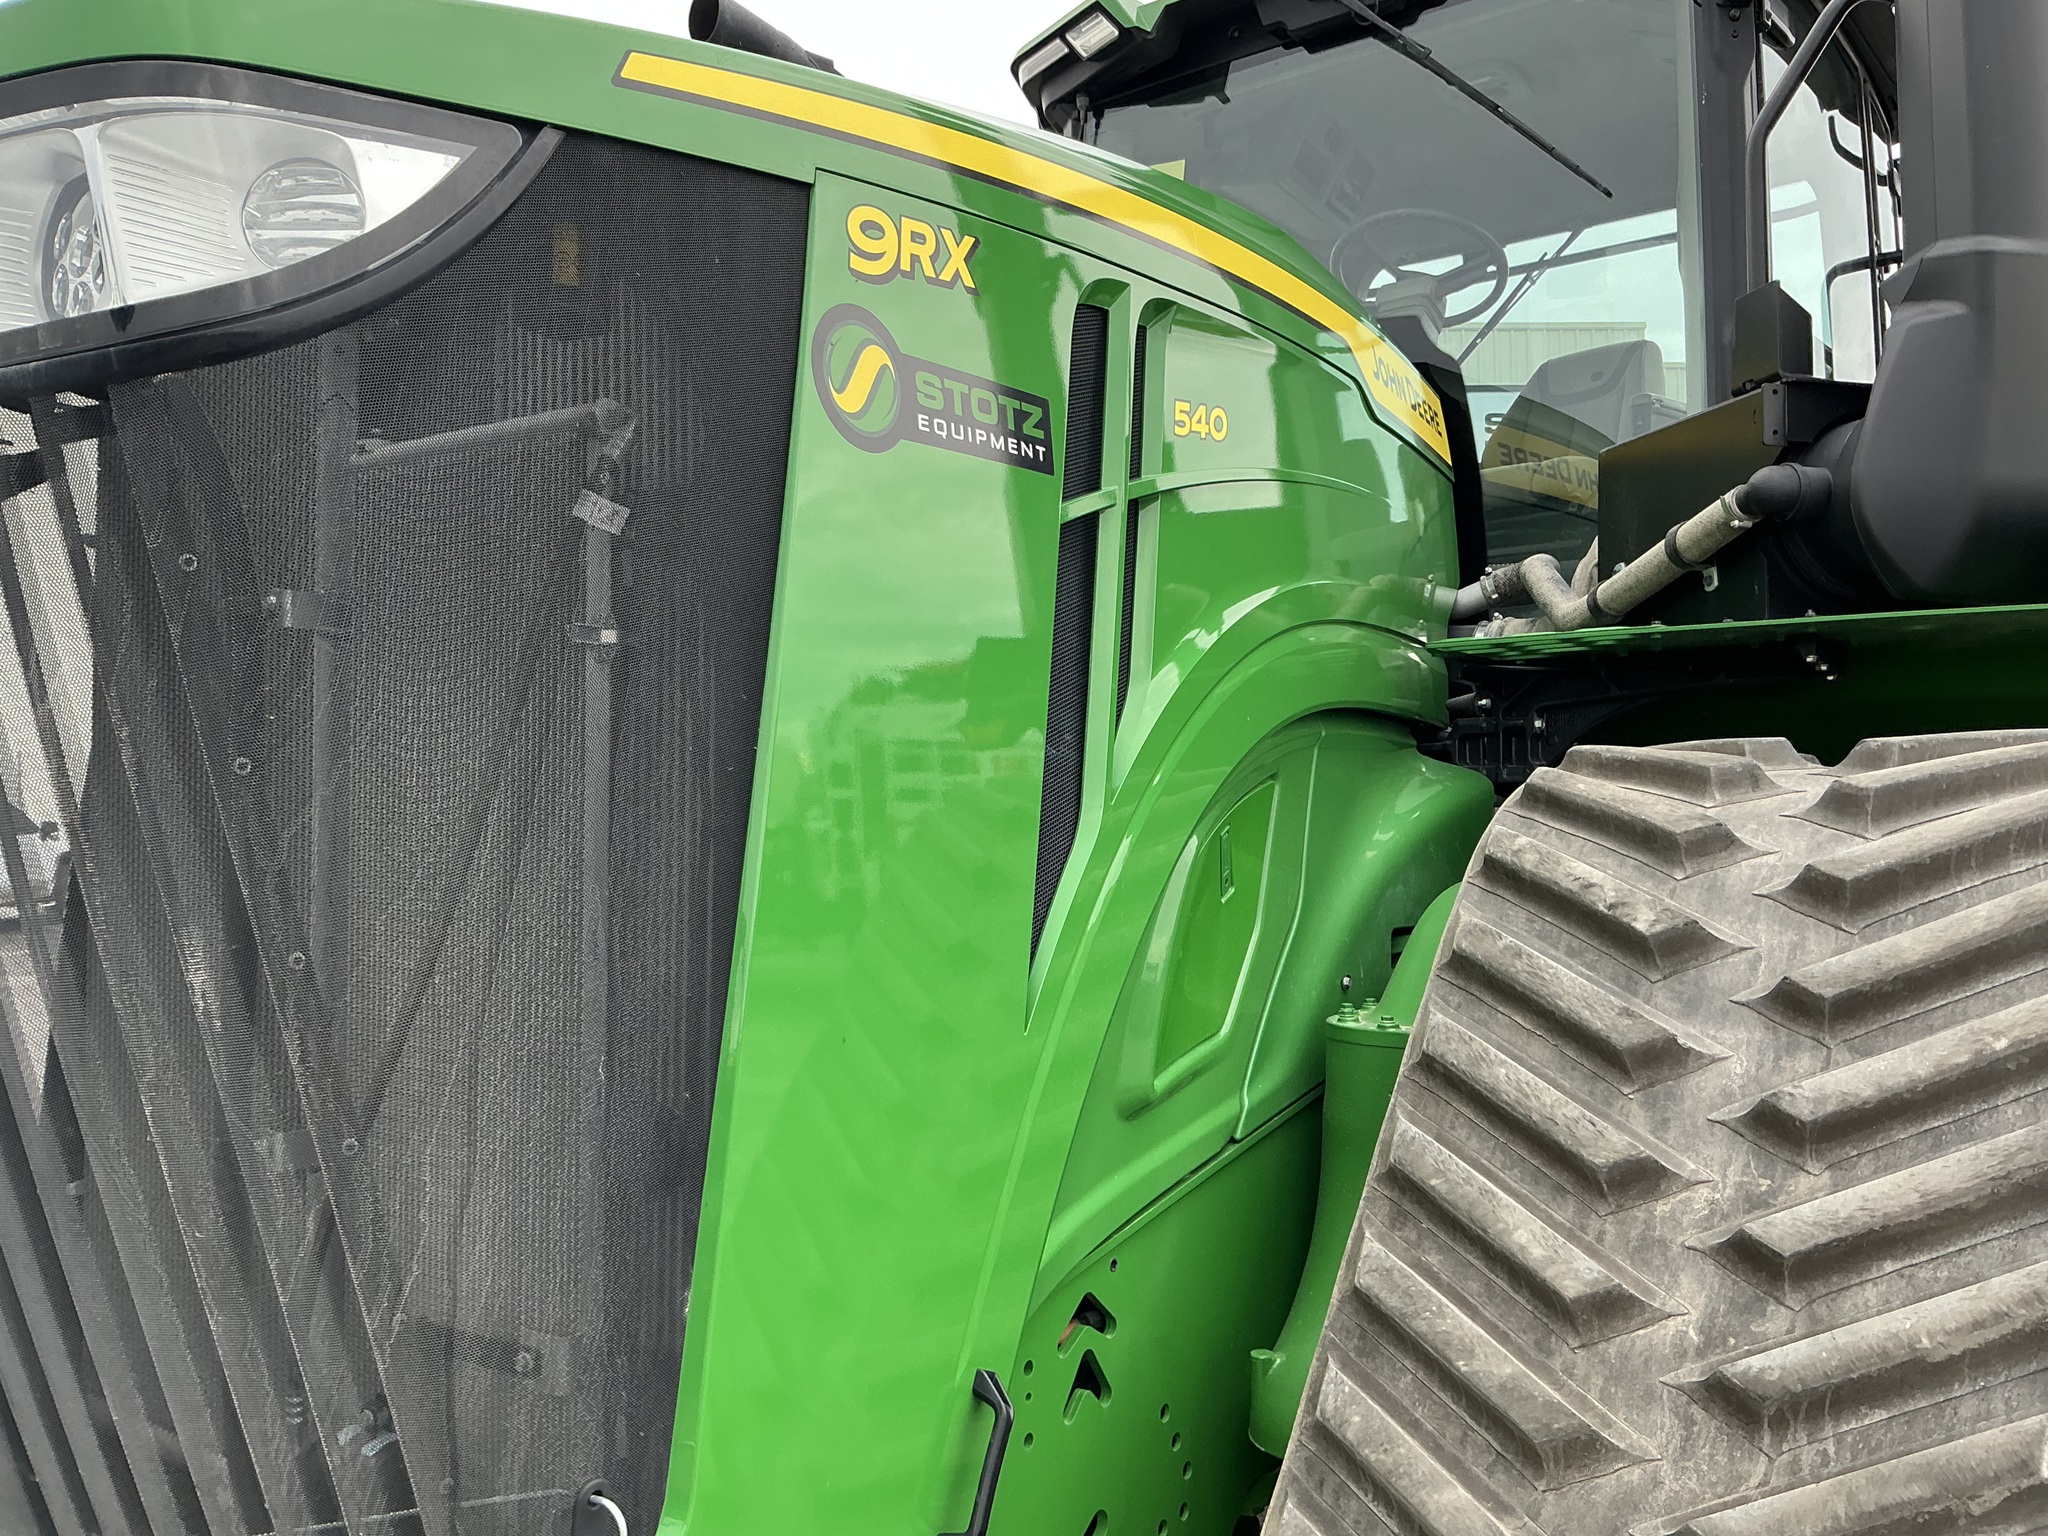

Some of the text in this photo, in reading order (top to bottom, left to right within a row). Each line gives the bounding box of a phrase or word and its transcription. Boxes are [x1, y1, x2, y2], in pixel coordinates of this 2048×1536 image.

[846, 203, 981, 295] 9RX
[915, 370, 1045, 440] STOTZ
[1173, 399, 1228, 442] 540
[1371, 345, 1443, 439] JOHN DEERE
[917, 413, 1047, 462] EQUIPMENT
